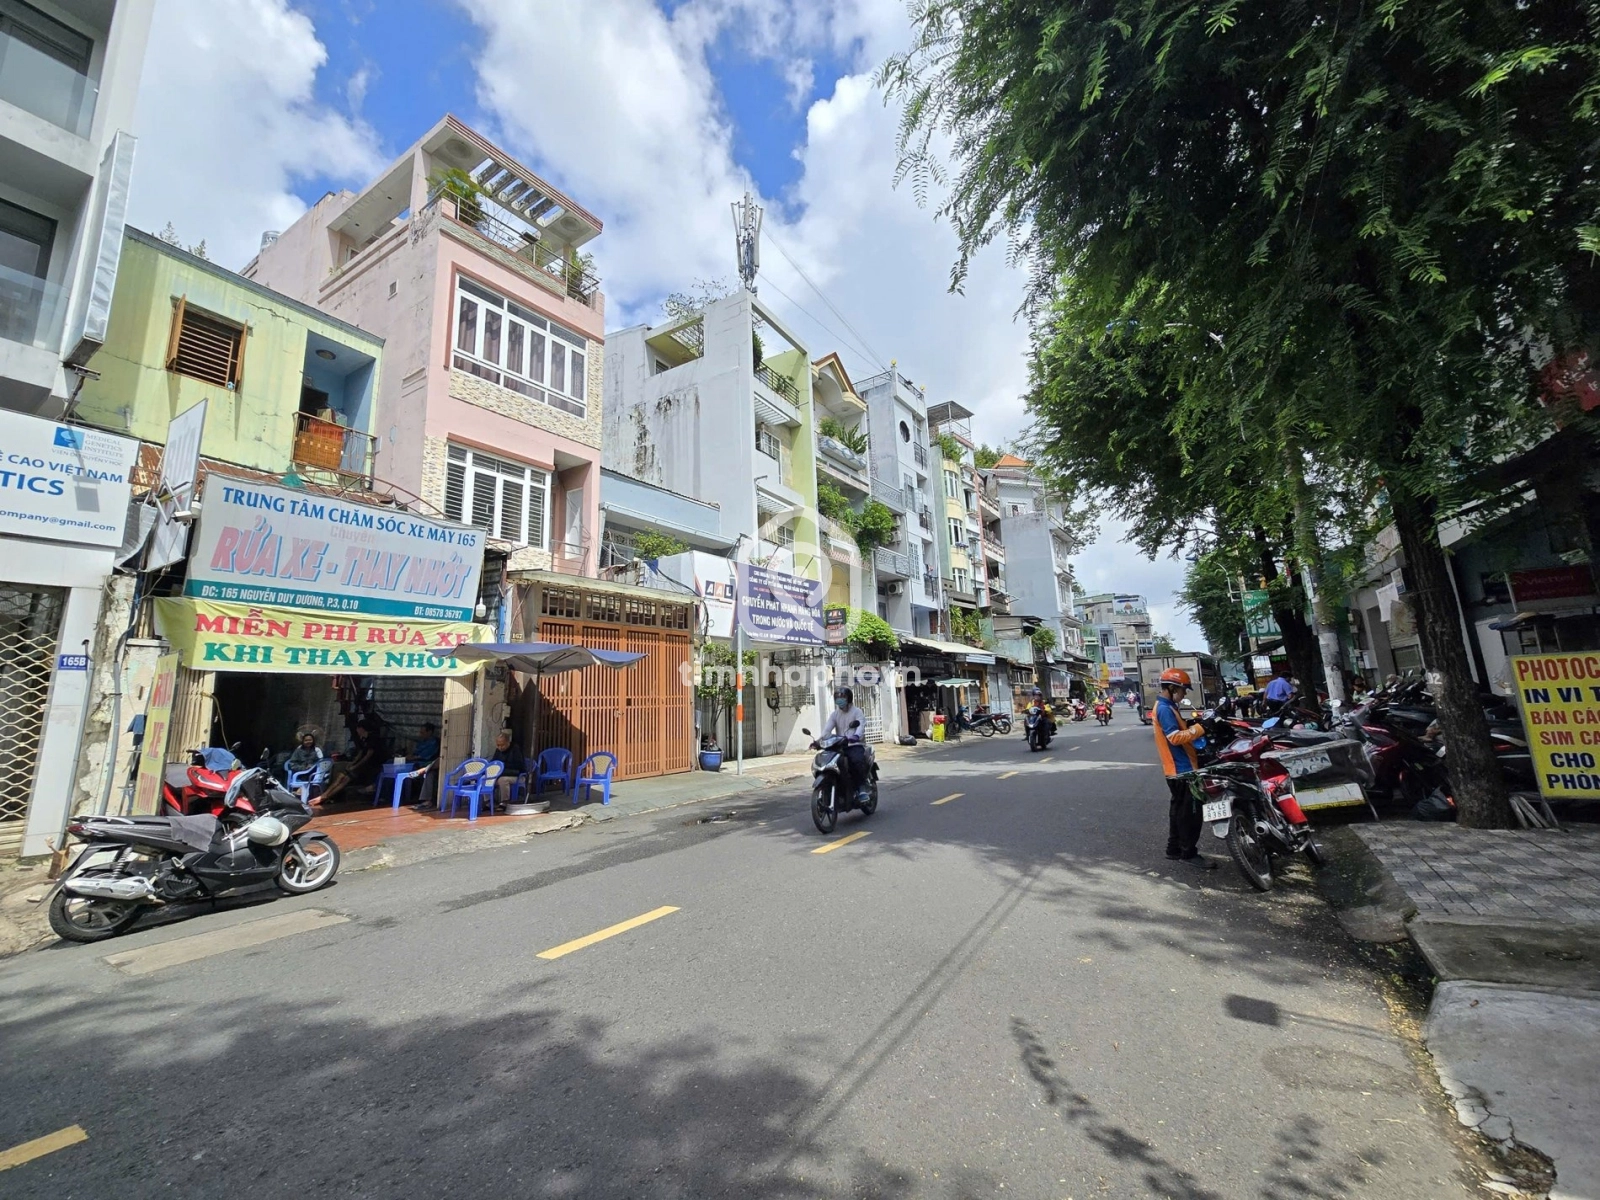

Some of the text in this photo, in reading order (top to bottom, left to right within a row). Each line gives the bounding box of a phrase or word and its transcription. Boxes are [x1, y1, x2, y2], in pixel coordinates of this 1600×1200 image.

[85, 440, 123, 452] GENETICS
[86, 434, 120, 446] MEDICAL
[84, 446, 124, 458] INSTITUTE
[8, 454, 44, 468] CAO
[49, 462, 84, 476] VIỆT
[88, 469, 122, 483] NAM
[0, 470, 64, 496] TICS
[223, 487, 476, 548] TRUNG TÂM CHĂM SÓC XE MÁY 165
[210, 514, 280, 580] RỬA
[280, 536, 330, 582] XE
[341, 546, 406, 592] THAY
[404, 550, 472, 600] NHỚT
[202, 585, 358, 610] ĐC: 165 NGUYỄN DUY DƯƠNG, P.3, Q.10
[706, 583, 732, 597] AAL
[194, 608, 469, 647] MIỄN PHÍ RỬA XE
[62, 656, 86, 666] 165B
[203, 642, 273, 664] KHI
[285, 646, 376, 668] THAY
[1516, 656, 1600, 682] PHOTOC
[1523, 688, 1550, 703] IN
[1557, 687, 1583, 702] VI
[1530, 707, 1600, 725] BÁN CÁ
[1540, 731, 1575, 745] SIM
[1550, 753, 1595, 768] CHO
